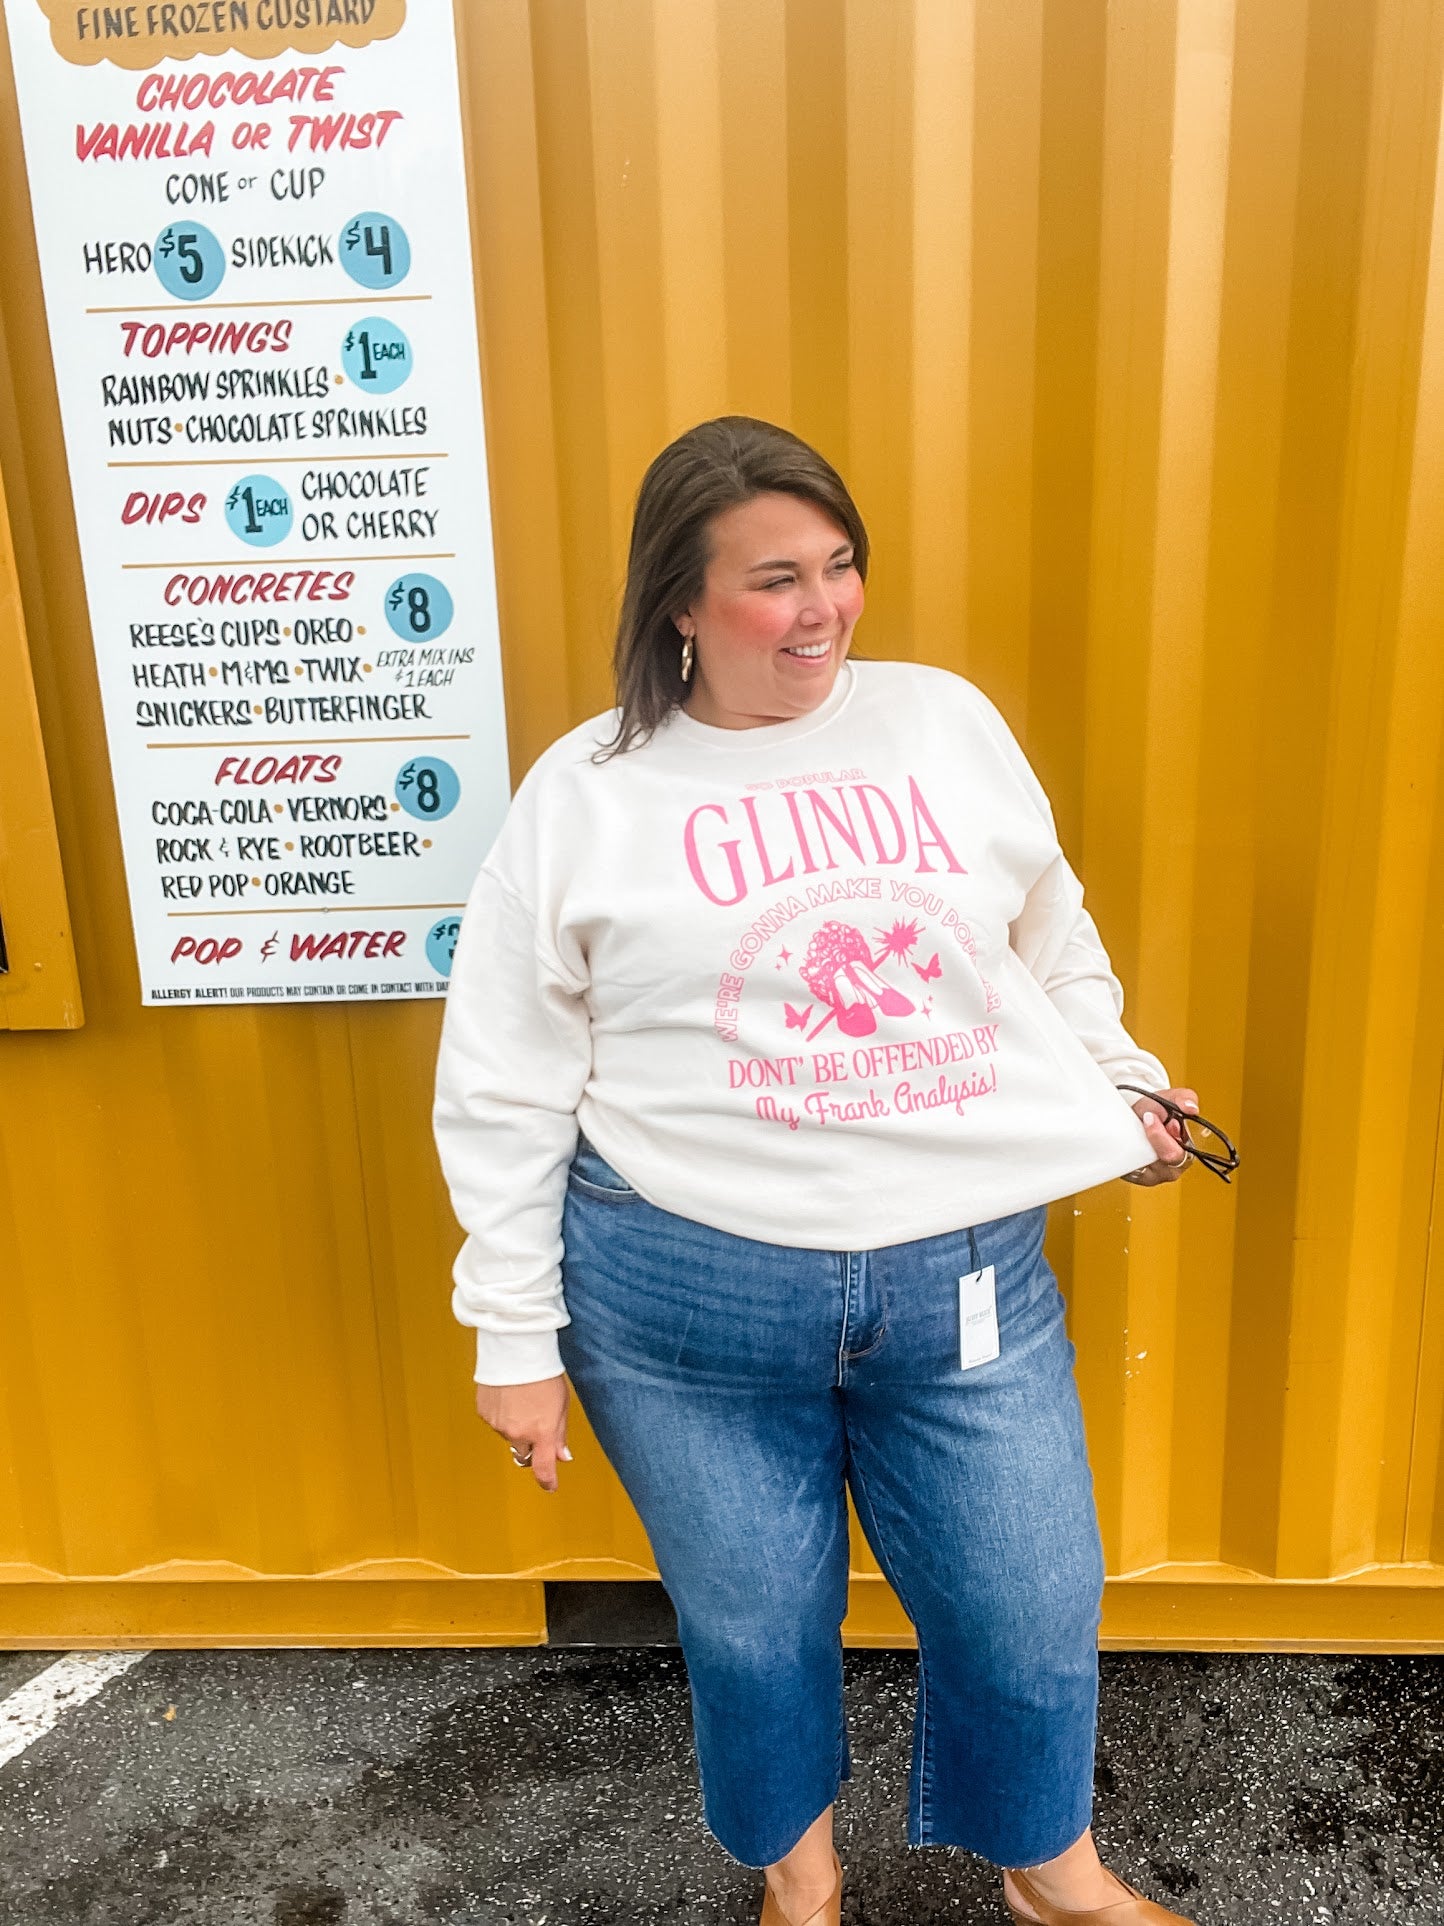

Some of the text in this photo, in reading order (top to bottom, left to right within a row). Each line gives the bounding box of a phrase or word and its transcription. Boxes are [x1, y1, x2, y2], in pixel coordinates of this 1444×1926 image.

[76, 0, 376, 41] FINE FROZEN CUSTARD
[136, 66, 345, 112] CHOCOLATE
[75, 110, 403, 162] VANILLA OR TWIST
[166, 166, 326, 205] CONE or CUP
[83, 220, 393, 284] HERO $5 SIDEKICK $4
[120, 319, 293, 358] TOPPINGS
[344, 331, 406, 379] $1 EACH
[102, 365, 330, 407] RAINBOW SPRINKLES
[108, 405, 428, 448] NUTS CHOCOLATE SPRINKLES
[301, 465, 431, 502] CHOCOLATE
[120, 485, 290, 534] DIPS $1 EACH
[302, 508, 440, 543] OR CHERRY
[163, 570, 356, 607] CONCRETES
[388, 581, 432, 634] $8
[129, 616, 353, 649] REESE'S CUPS OREO
[131, 661, 206, 690] HEATH
[300, 656, 364, 684] TWIX
[376, 648, 416, 668] EXTRA
[416, 667, 456, 689] EACH
[135, 693, 433, 728] SNICKERS BUTTERFINGER
[214, 753, 343, 786] FLOATS
[398, 763, 441, 814] $8
[776, 768, 868, 789] POPULAR
[151, 793, 389, 826] COCA-COLA VERNORS
[156, 836, 213, 864] ROCK
[218, 837, 231, 858] &
[237, 835, 280, 863] RYE
[683, 775, 968, 907] GLINDA
[161, 868, 356, 899] RED POP ORANGE
[170, 930, 408, 967] POP & WATER
[714, 878, 1001, 1043] WE'RE GONNA MAKE YOU POPAR
[151, 988, 191, 1000] ALLERGY
[195, 986, 228, 999] ALERT!
[230, 986, 244, 998] OUR
[246, 985, 285, 997] PRODUCTS
[286, 984, 302, 996] MAY
[304, 983, 334, 996] CONTAIN
[336, 983, 347, 995] OR
[348, 983, 368, 995] COME
[371, 983, 379, 993] IN
[380, 981, 413, 993] CONTACT
[414, 981, 434, 993] WITH
[812, 1052, 849, 1084] BE
[852, 1036, 975, 1077] OFFENDED
[974, 1024, 999, 1051] BY
[756, 1065, 998, 1131] My Frank Analysis!
